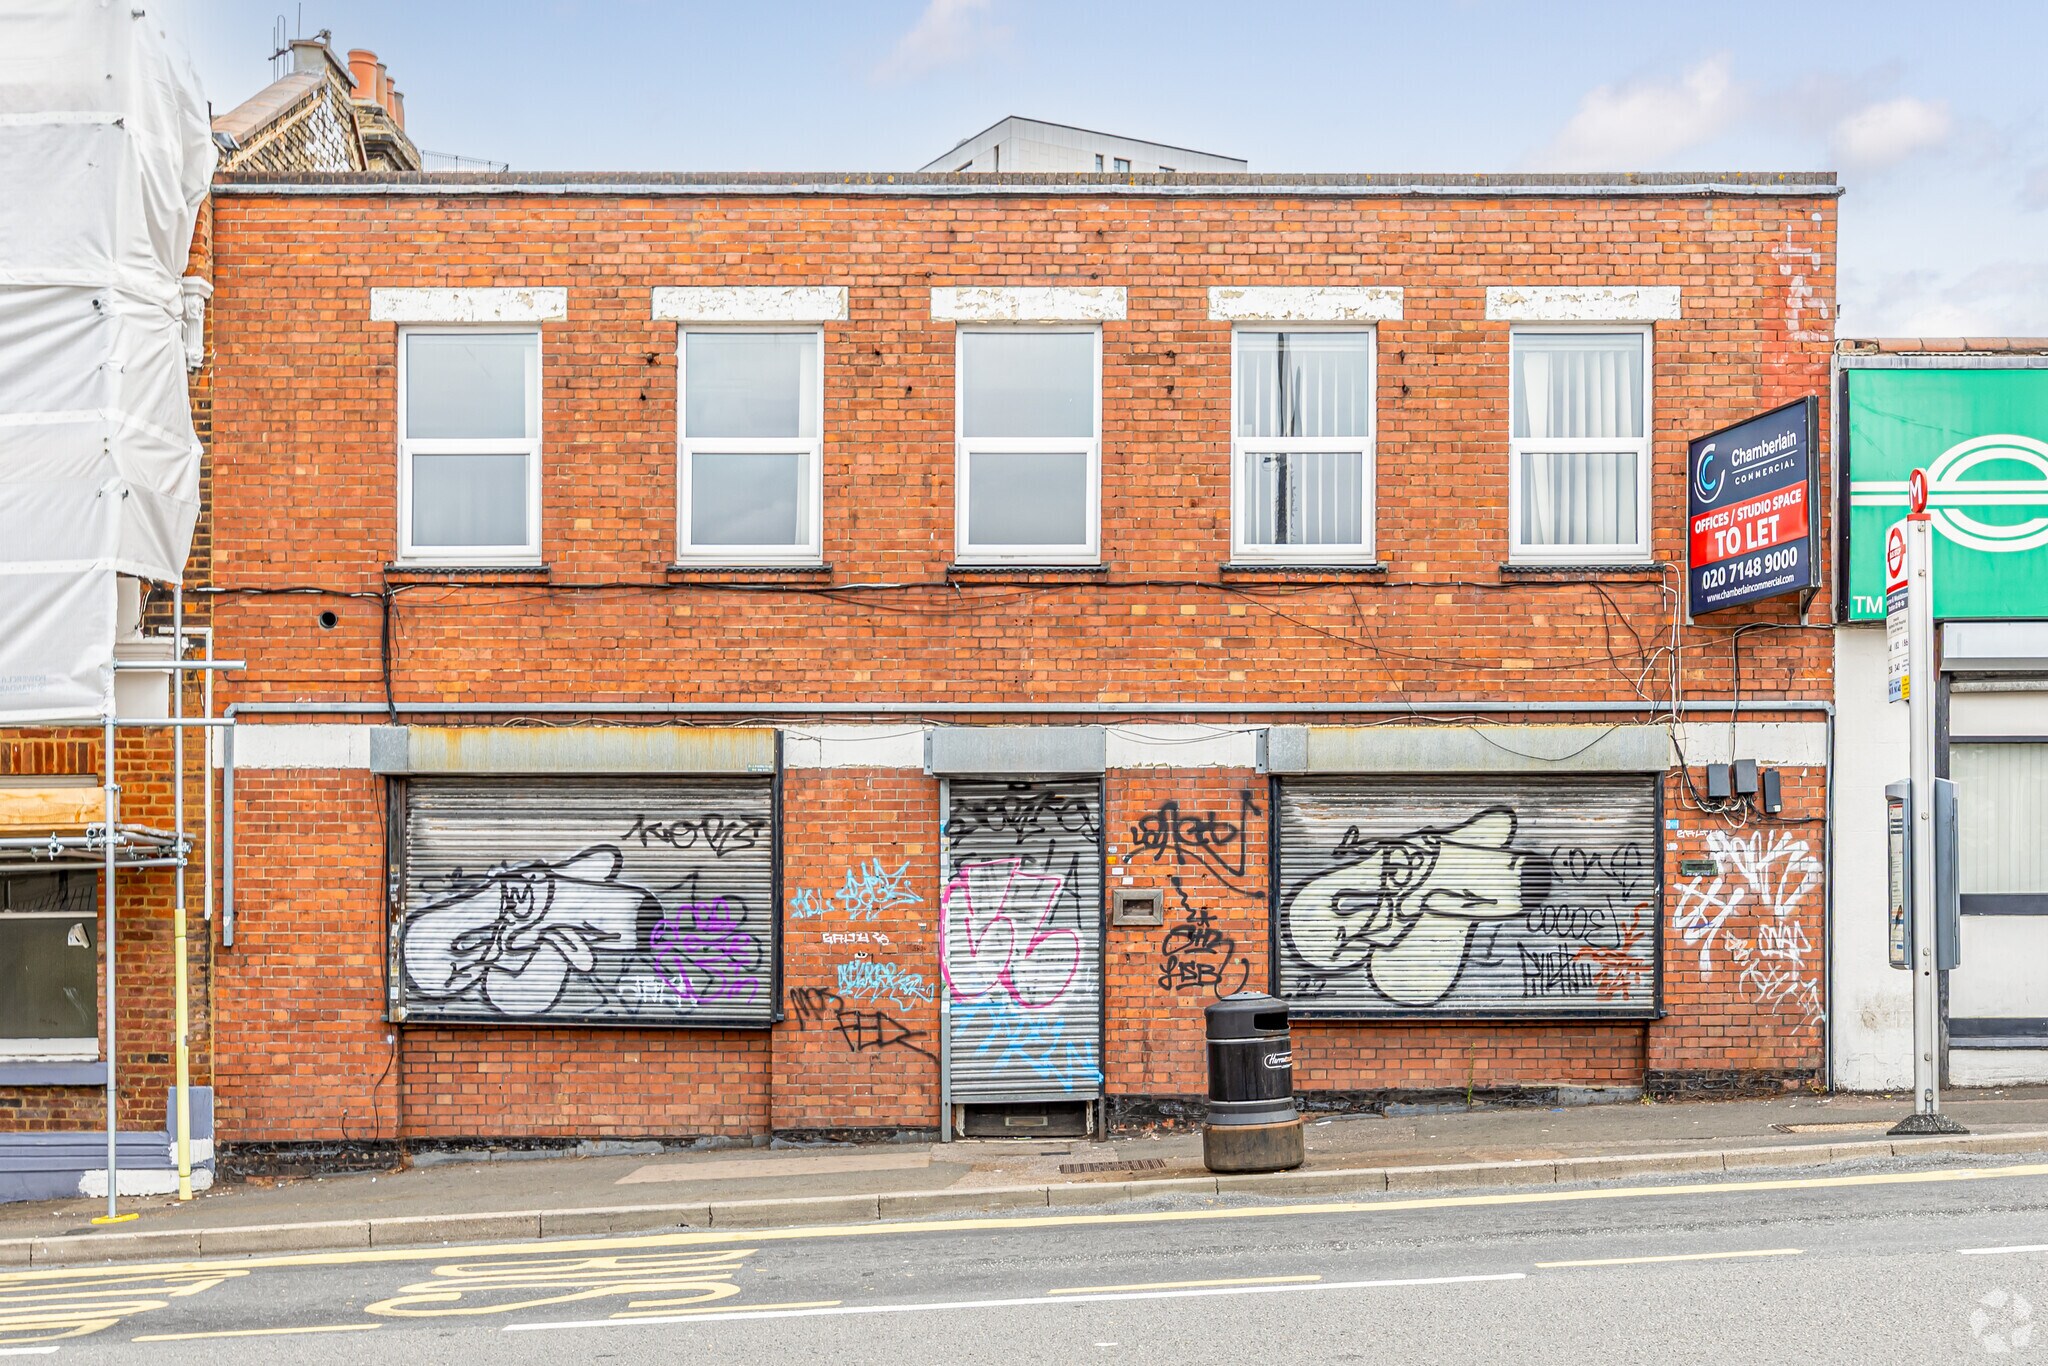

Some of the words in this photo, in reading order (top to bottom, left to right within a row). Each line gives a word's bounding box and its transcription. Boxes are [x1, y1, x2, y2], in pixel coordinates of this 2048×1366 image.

[1731, 430, 1797, 467] Chamberlain
[1735, 459, 1795, 485] COMMERCIAL
[1909, 474, 1923, 509] M
[1695, 511, 1729, 534] OFFICES
[1730, 508, 1736, 526] /
[1737, 499, 1771, 521] STUDIO
[1773, 488, 1802, 511] SPACE
[1715, 529, 1742, 557] TO
[1746, 515, 1780, 549] LET
[1702, 569, 1726, 590] 020
[1729, 557, 1762, 583] 7148
[1765, 546, 1798, 573] 9000
[1706, 573, 1795, 603] www.chamberlaincommercial.com
[1852, 595, 1883, 614] TM
